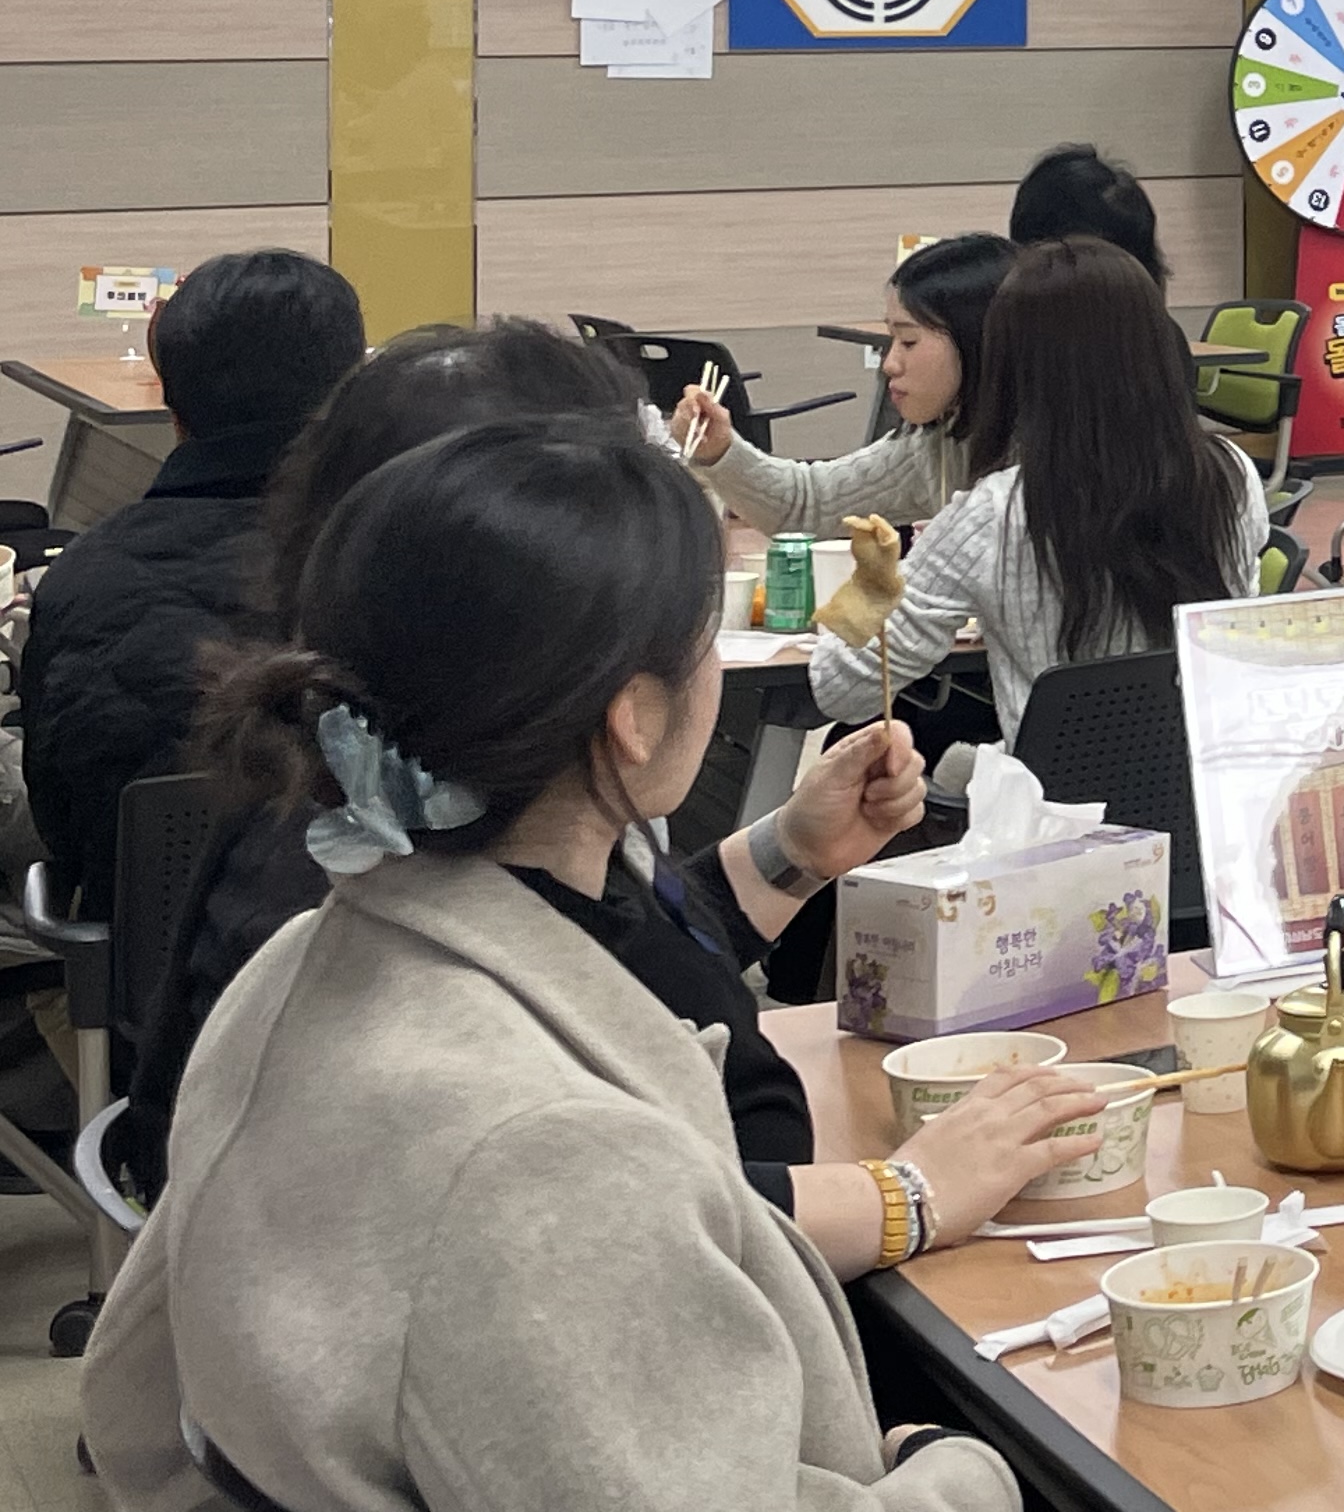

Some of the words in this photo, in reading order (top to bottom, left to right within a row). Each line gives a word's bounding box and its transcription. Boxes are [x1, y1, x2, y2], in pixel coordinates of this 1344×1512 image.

[995, 928, 1038, 955] 행복한
[989, 953, 1043, 979] 아침나라
[912, 1087, 963, 1103] Chees
